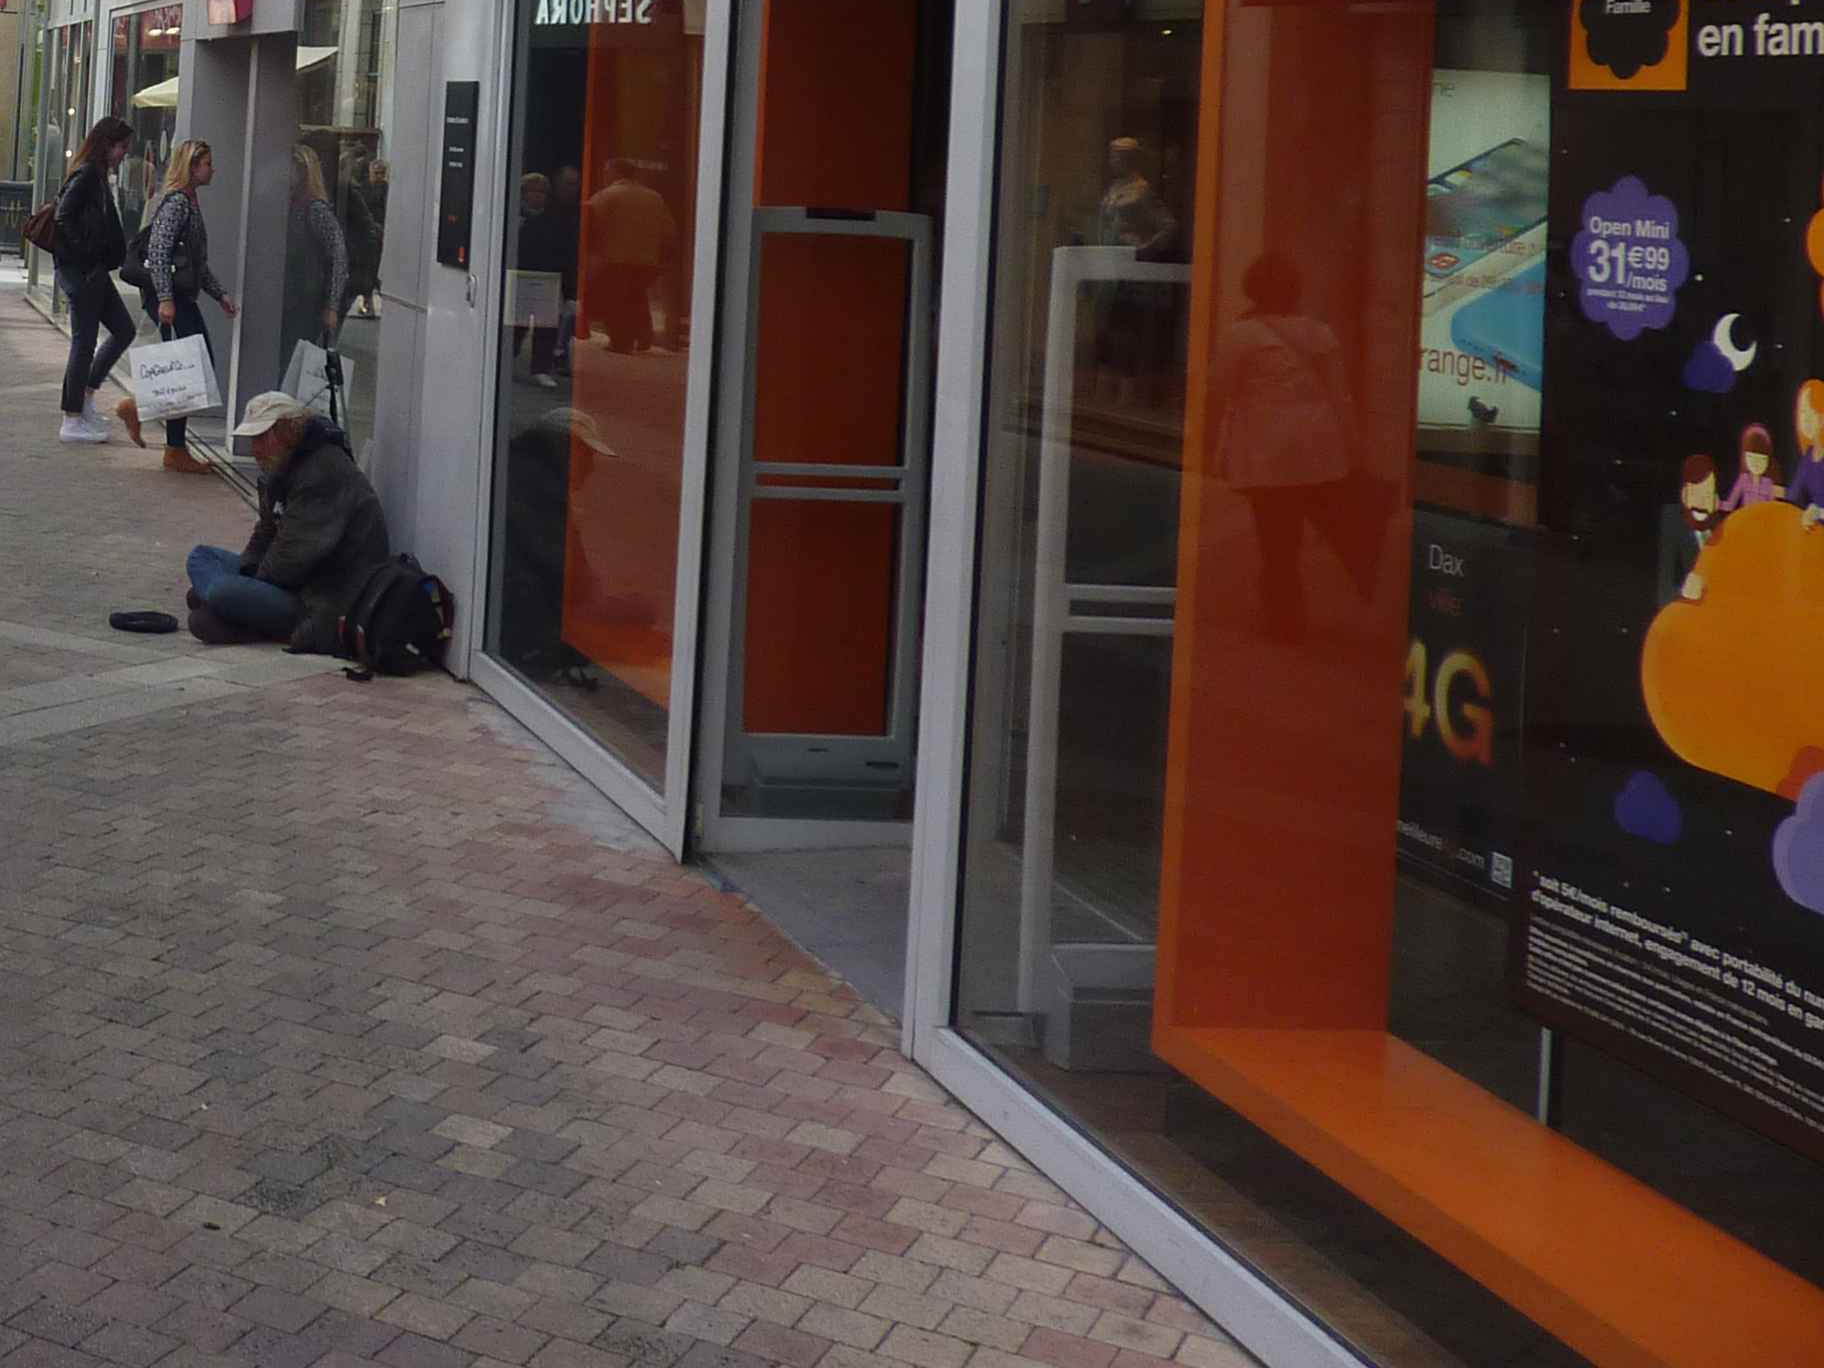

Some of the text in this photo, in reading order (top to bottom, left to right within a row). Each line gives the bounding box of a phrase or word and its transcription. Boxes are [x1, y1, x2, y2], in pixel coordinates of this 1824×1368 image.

[1698, 24, 1744, 57] en
[1589, 215, 1670, 240] Open Mini
[1429, 543, 1464, 578] Dax
[1404, 638, 1494, 765] 4G
[1741, 978, 1756, 997] 12
[1757, 987, 1786, 1012] mois
